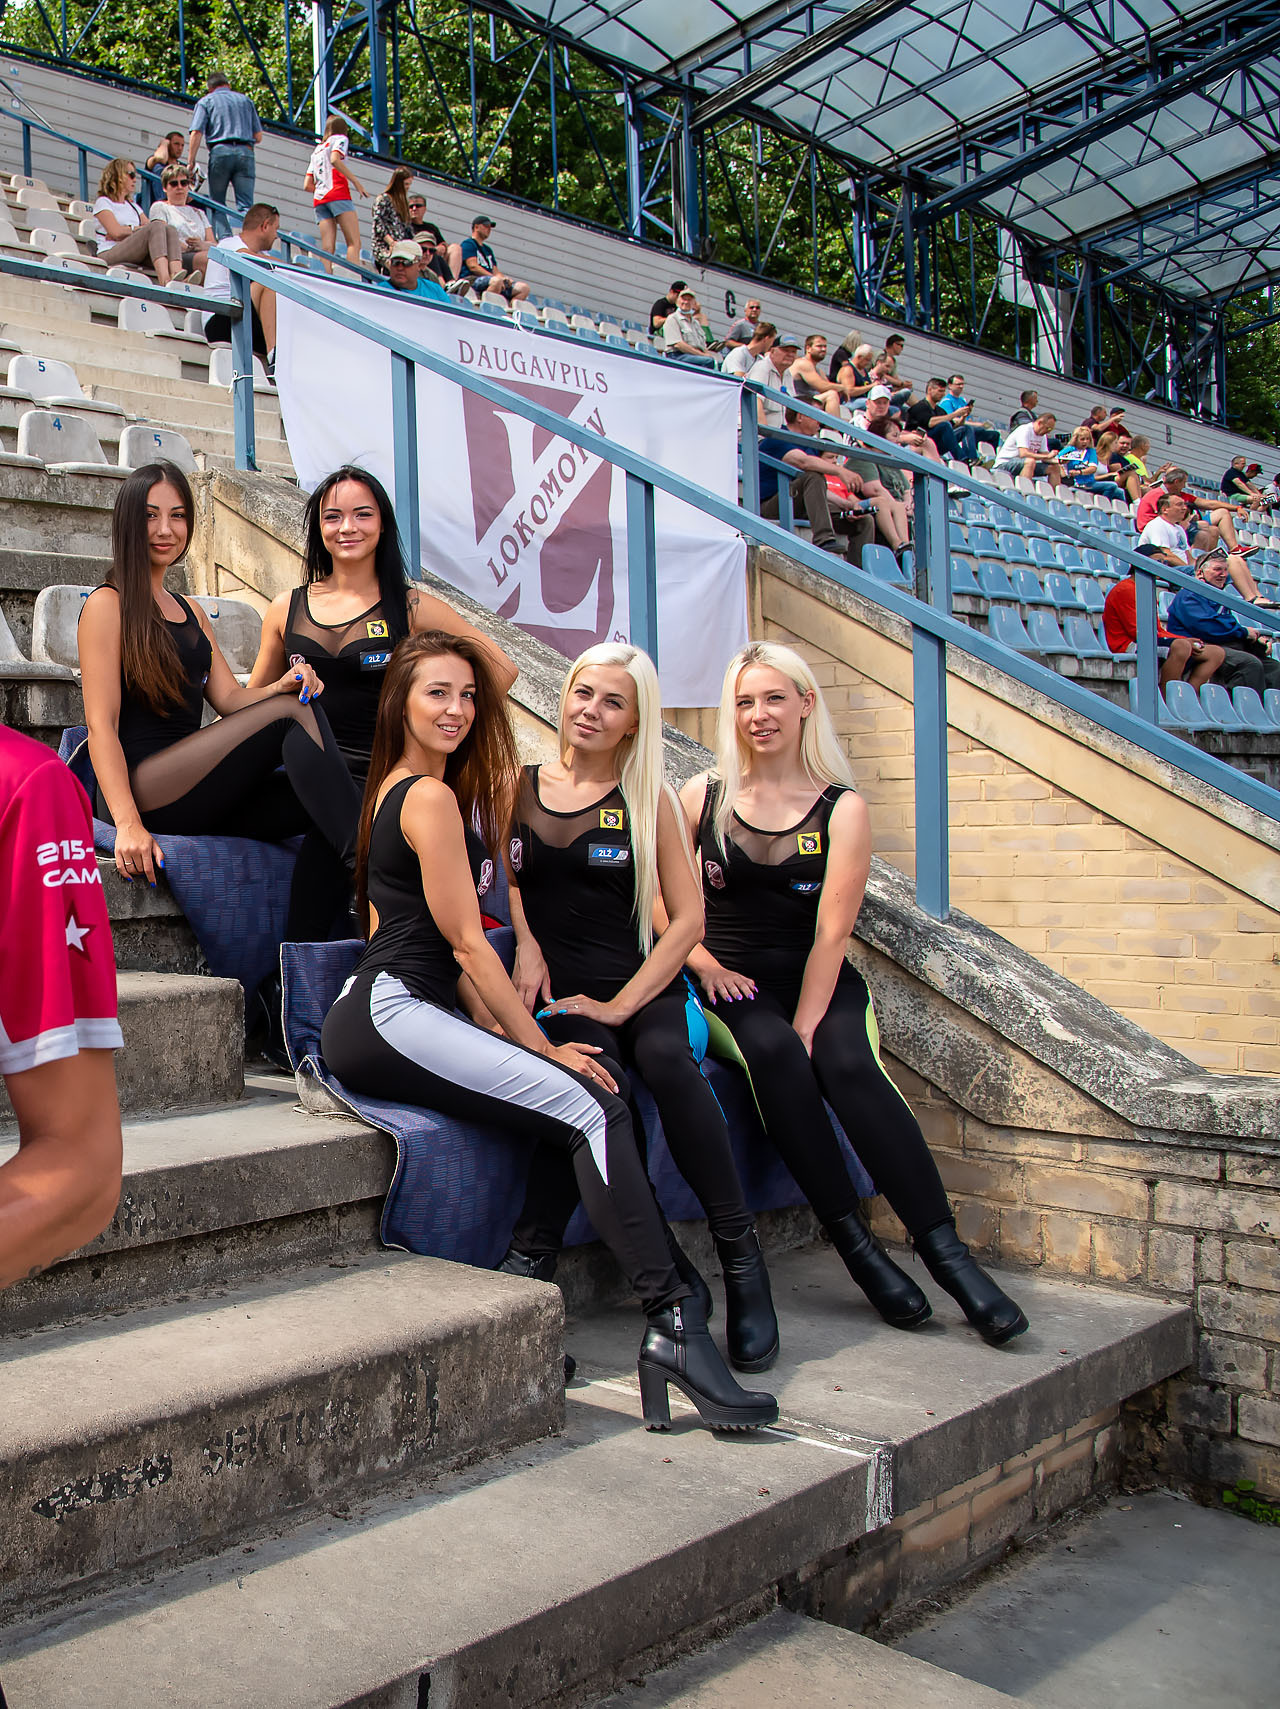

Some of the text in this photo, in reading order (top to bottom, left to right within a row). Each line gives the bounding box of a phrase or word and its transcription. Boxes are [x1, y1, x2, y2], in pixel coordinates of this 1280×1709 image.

[51, 234, 57, 242] 7
[125, 272, 131, 280] 7
[141, 303, 147, 313] 6
[37, 360, 47, 373] 5
[458, 338, 610, 394] DAUGAVPILS
[52, 417, 63, 432] 4
[153, 433, 162, 448] 5
[487, 407, 607, 588] LOKOMOTV
[43, 867, 102, 888] CAM
